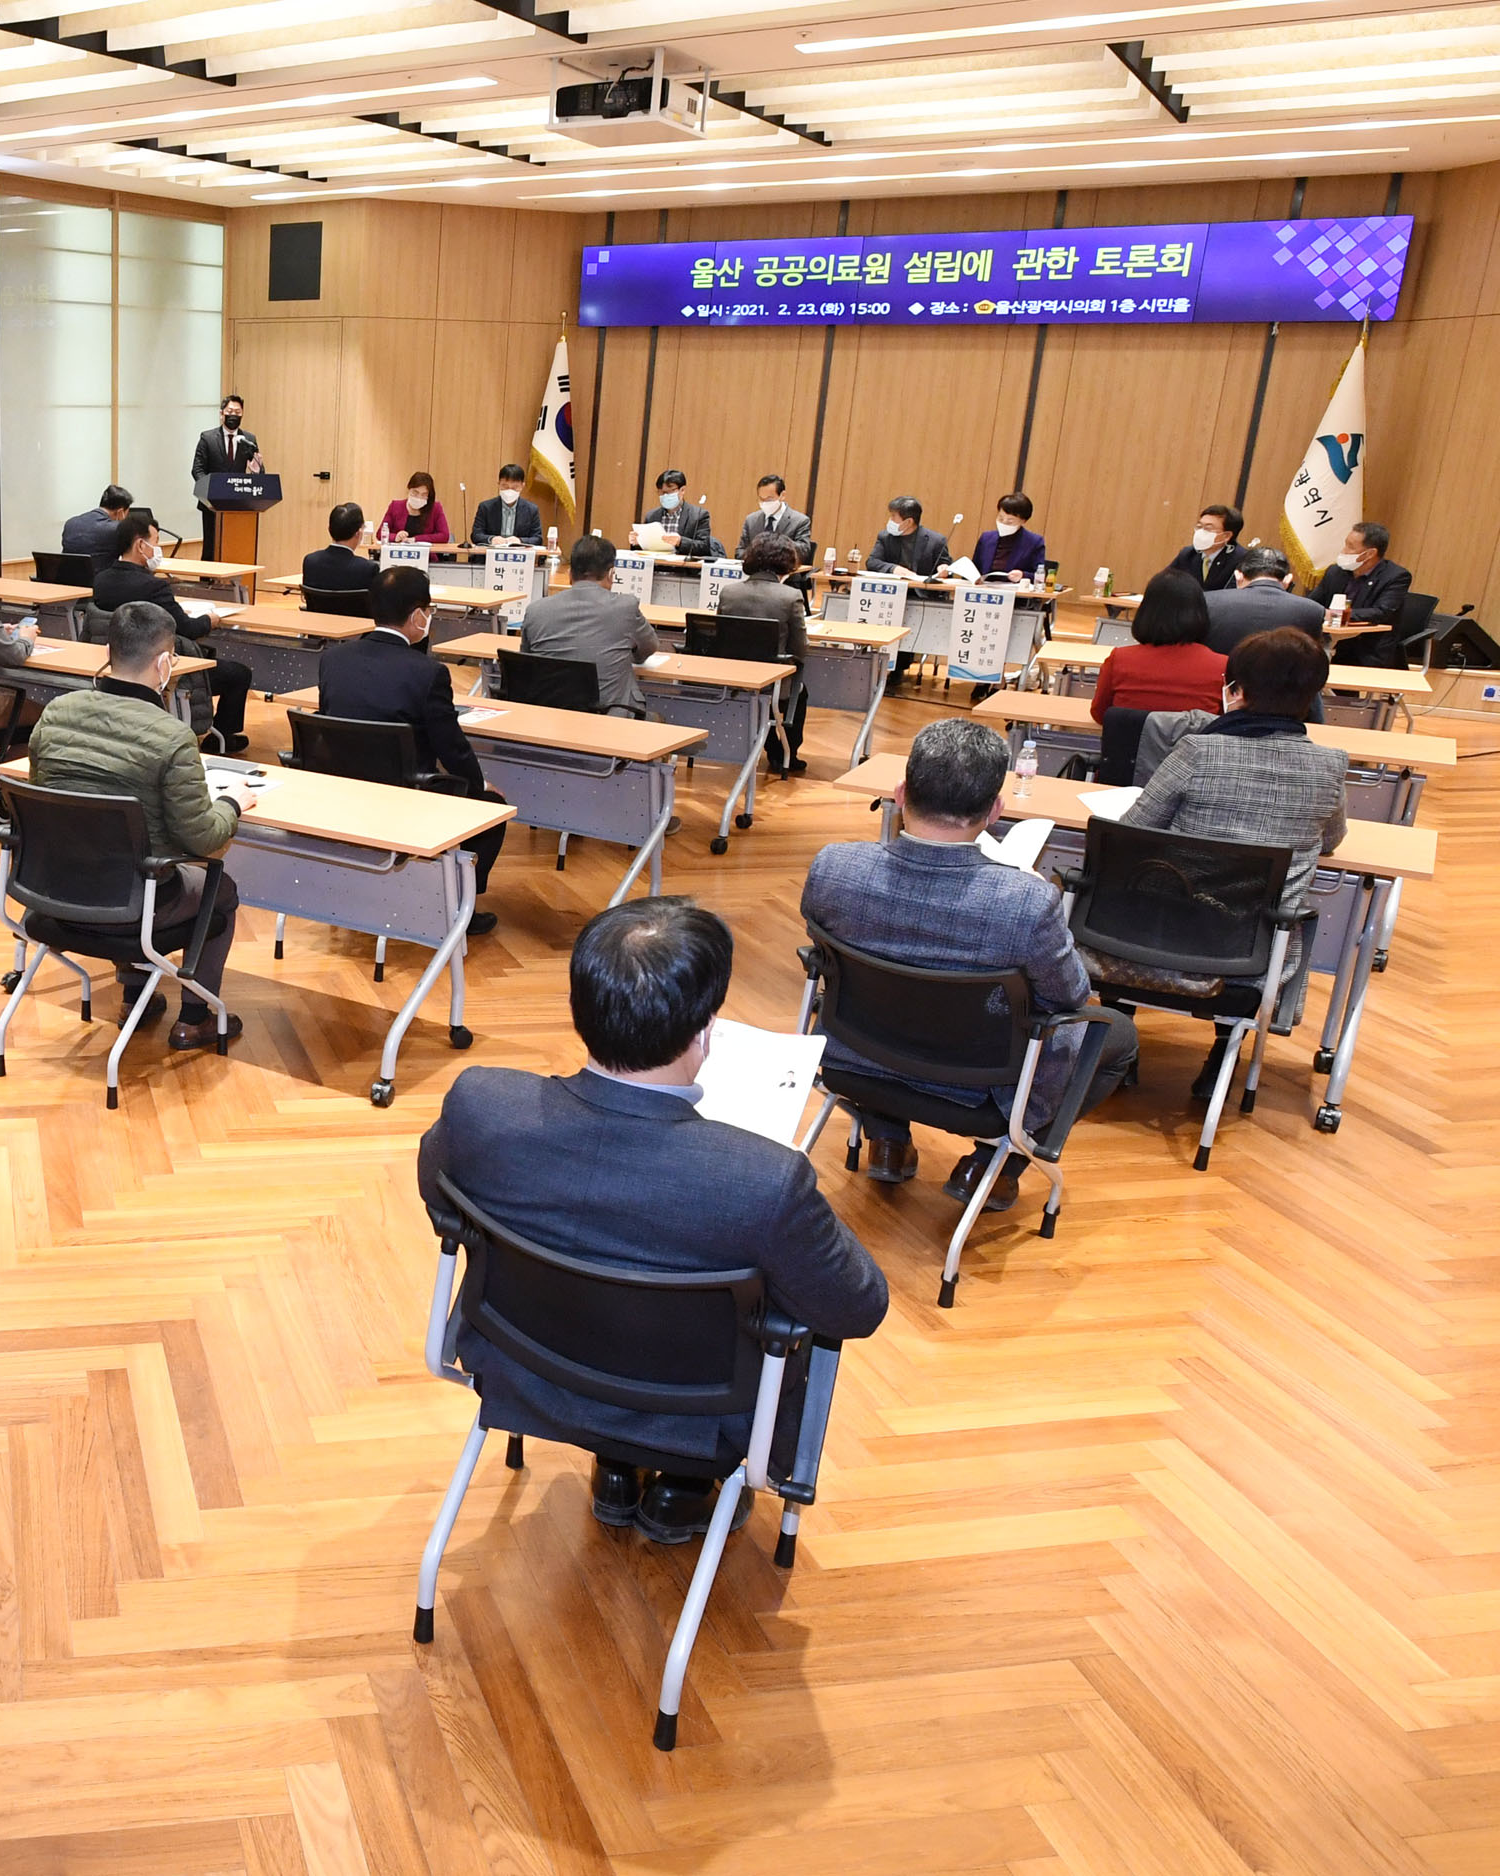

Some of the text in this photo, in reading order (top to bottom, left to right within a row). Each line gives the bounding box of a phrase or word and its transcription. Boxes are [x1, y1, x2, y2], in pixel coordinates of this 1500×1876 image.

[690, 242, 1194, 288] 울산 공공의료원 설립에 관한 토론회
[778, 304, 791, 315] 2.
[850, 302, 891, 315] 15:00
[995, 299, 1105, 315] 울산광역시의회
[1111, 299, 1137, 313] 1층
[1138, 298, 1190, 313] 시민홀
[1294, 461, 1334, 528] 광역시
[958, 608, 976, 664] 김장년
